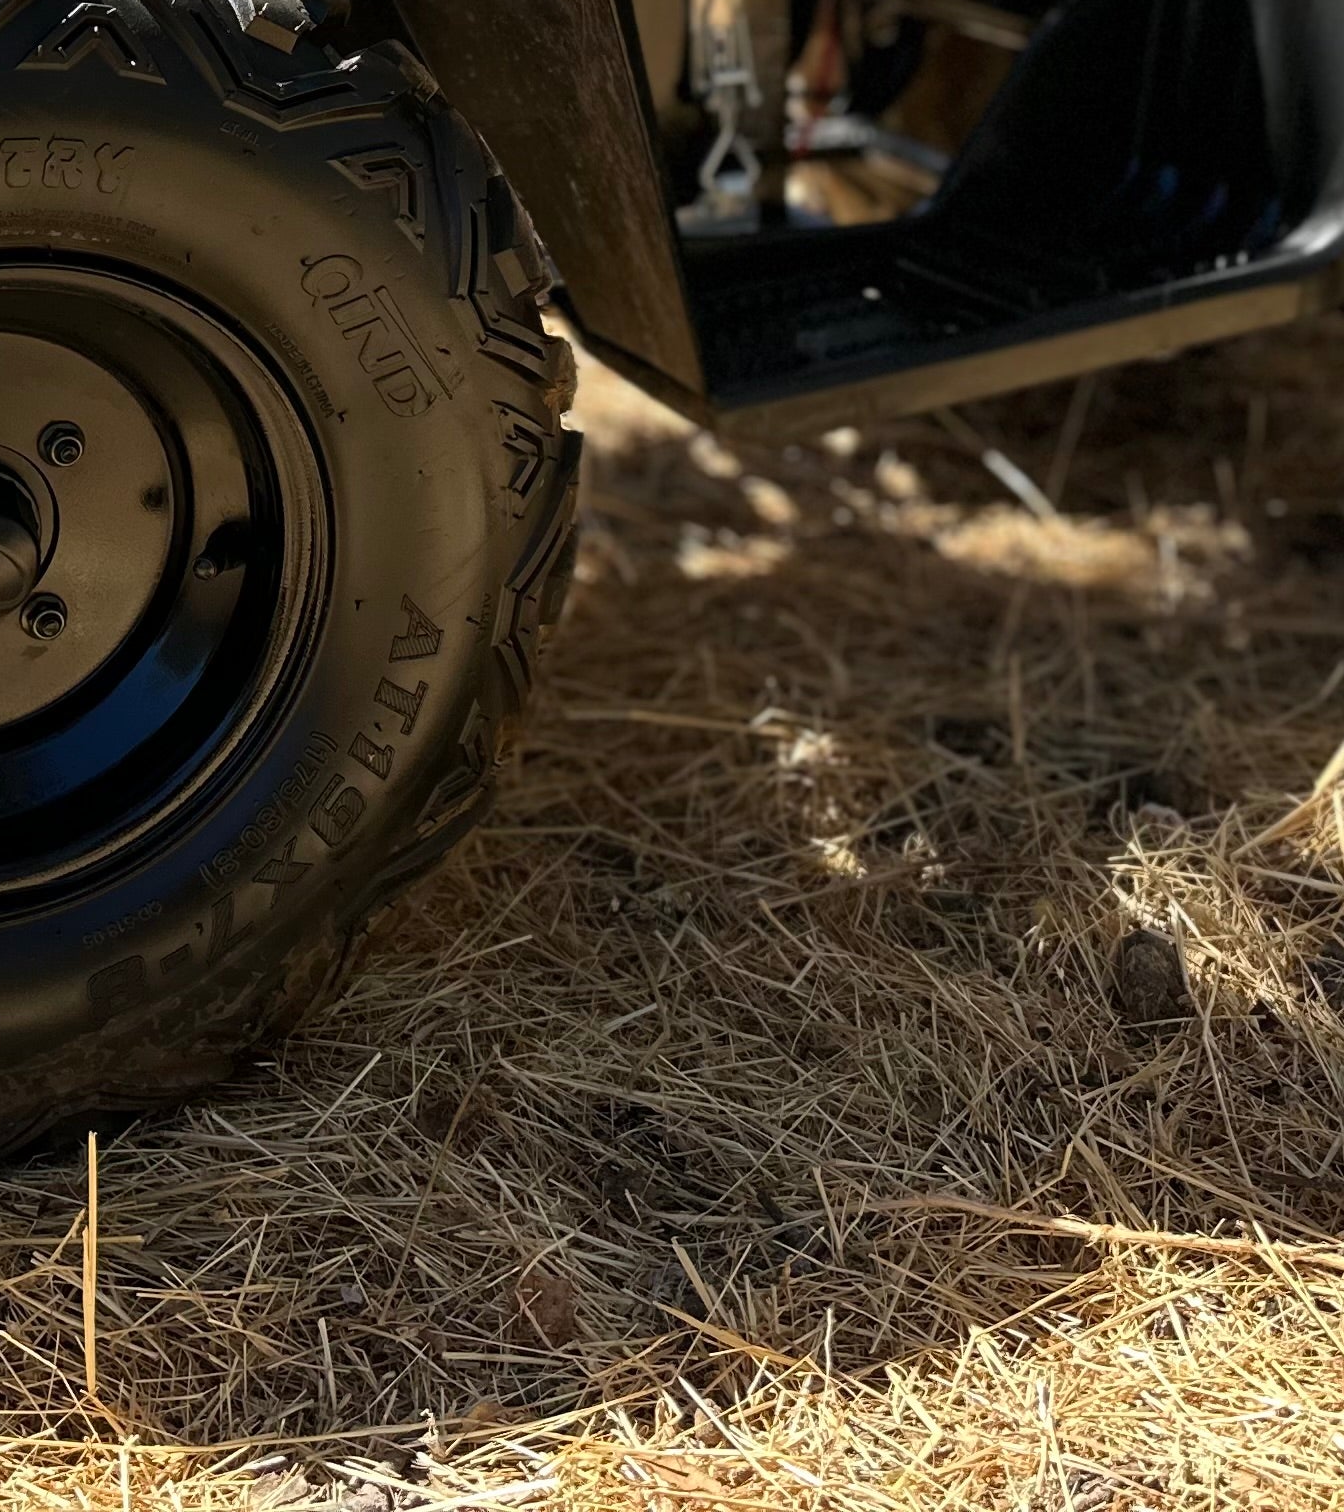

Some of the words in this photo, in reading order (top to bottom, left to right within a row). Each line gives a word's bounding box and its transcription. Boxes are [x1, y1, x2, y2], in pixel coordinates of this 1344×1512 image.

[264, 322, 304, 360] MADE
[296, 358, 313, 376] IN
[305, 374, 336, 419] CHINA
